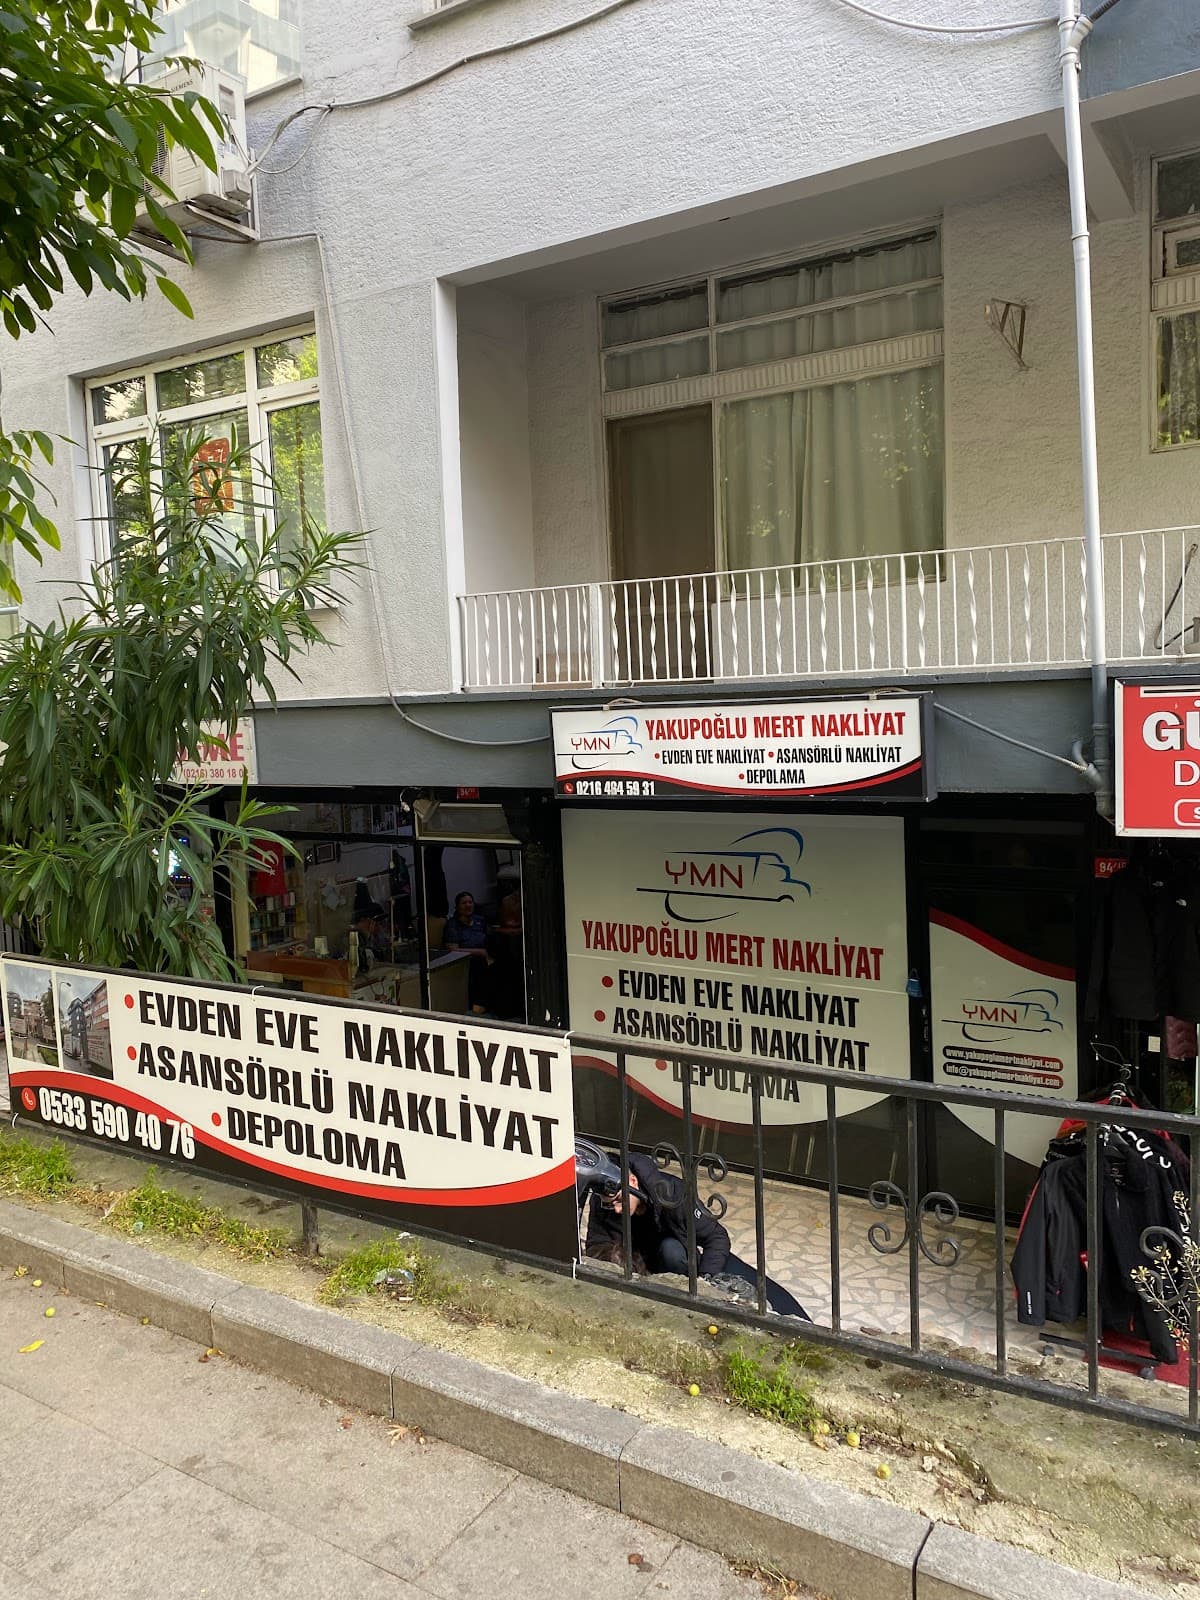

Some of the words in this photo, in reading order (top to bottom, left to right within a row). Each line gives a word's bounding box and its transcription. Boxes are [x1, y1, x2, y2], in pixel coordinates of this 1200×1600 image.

[645, 712, 747, 741] YAKUPOĞLU
[753, 715, 805, 738] MERT
[811, 708, 906, 737] NAKLİYAT
[571, 737, 611, 751] YMN
[662, 750, 692, 764] EVDEN
[695, 750, 713, 764] EVE
[716, 746, 765, 764] NAKLİYAT
[776, 745, 842, 764] ASANSÖRLÜ
[846, 744, 902, 763] NAKLİYAT
[210, 768, 225, 779] 380
[576, 781, 602, 795] 0216
[626, 781, 640, 795] 59
[642, 781, 655, 795] 31
[746, 769, 806, 784] DEPOLAMA
[665, 860, 743, 889] YMN
[582, 920, 698, 961] YAKUPOĞLU
[705, 931, 765, 968] MERT
[772, 937, 884, 981] NAKLİYAT
[618, 969, 687, 1005] EVDEN
[694, 978, 733, 1012] EVE
[741, 984, 860, 1028] NAKLİYAT
[962, 1004, 1018, 1024] YMN
[139, 990, 242, 1040] EVDEN
[255, 1007, 319, 1054] EVE
[343, 1020, 559, 1093] NAKLİYAT
[612, 1007, 742, 1053] ASANSÖRLÜ
[751, 1025, 870, 1072] NAKLİYAT
[138, 1042, 334, 1114] ASANSÖRLÜ
[348, 1081, 559, 1159] NAKLİYAT
[38, 1087, 87, 1131] 0533
[91, 1100, 130, 1142] 590
[135, 1111, 162, 1150] 40
[166, 1119, 196, 1160] 76
[227, 1106, 406, 1180] DEPOLOMA
